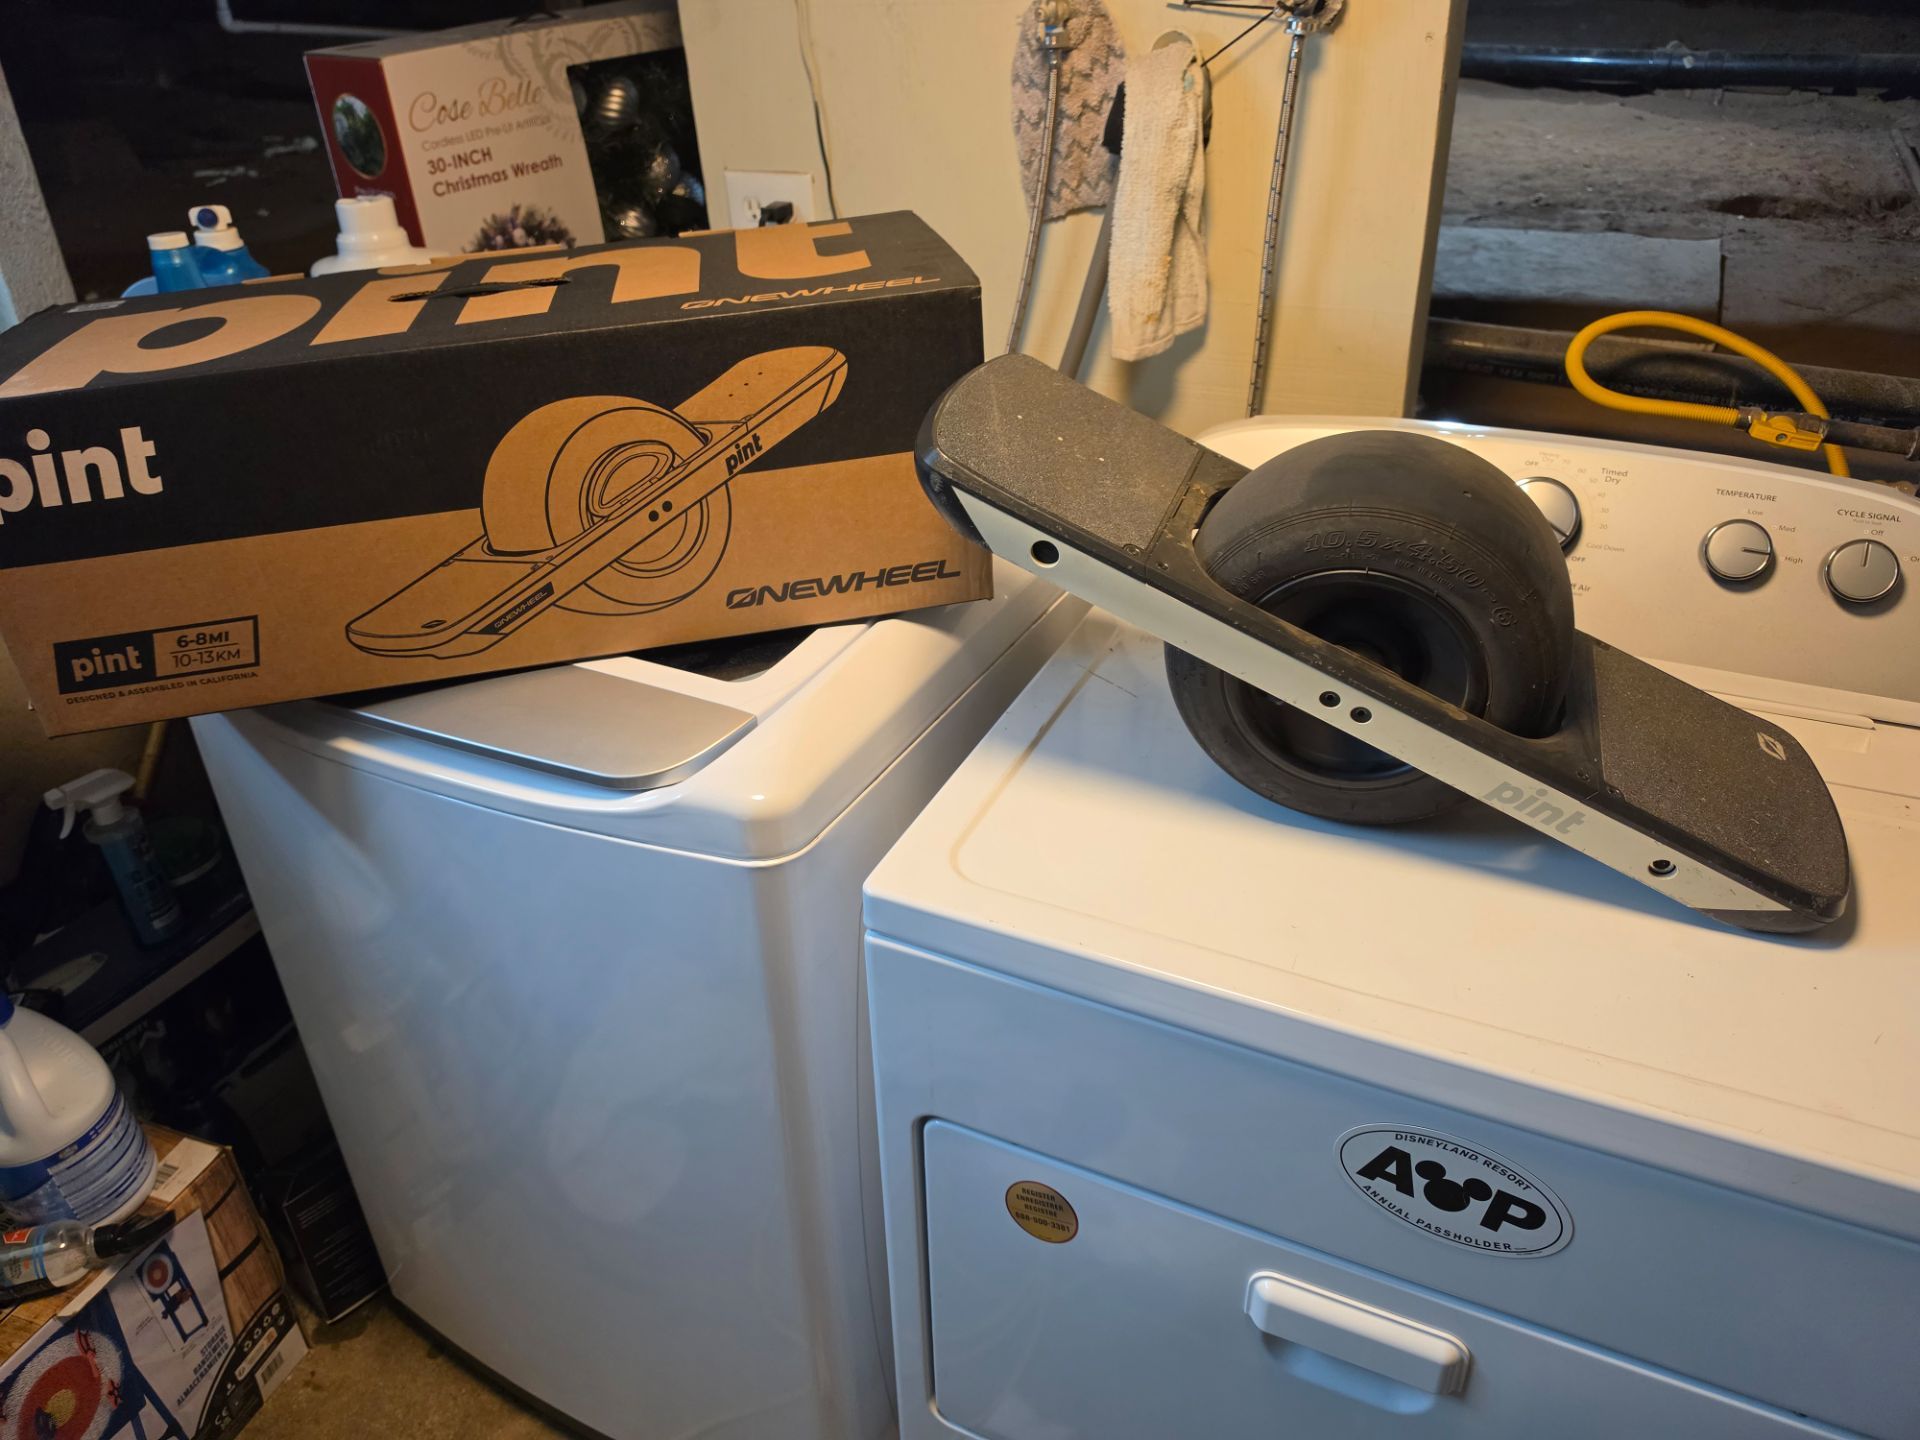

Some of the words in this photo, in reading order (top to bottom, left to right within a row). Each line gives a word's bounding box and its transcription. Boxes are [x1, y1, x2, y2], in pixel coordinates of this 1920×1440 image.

[409, 91, 472, 132] Cose
[477, 76, 544, 116] Belle
[465, 129, 484, 143] LED
[426, 147, 493, 176] 30-INCH
[432, 169, 508, 197] Christmas
[510, 153, 563, 178] Wreath
[725, 432, 763, 475] pint
[1601, 467, 1628, 477] Timed
[1604, 475, 1622, 485] Dry
[1716, 488, 1777, 502] TEMPERATURE
[1836, 508, 1866, 519] CYCLE
[1867, 511, 1902, 523] SIGNAL
[1870, 528, 1885, 536] Off
[1784, 555, 1804, 565] High
[71, 645, 142, 683] pint
[172, 648, 241, 669] 10-13KM
[66, 692, 116, 705] DESIGNED
[118, 690, 126, 698] &
[127, 682, 185, 696] ASSEMBLED
[199, 671, 258, 685] CALIFORNIA
[1482, 781, 1587, 834] pint
[1394, 1133, 1478, 1161] DISNEYLAND
[1483, 1159, 1532, 1191] RESORT
[1021, 1187, 1056, 1203] REGISTER
[1362, 1185, 1411, 1220] ANNUAL
[1415, 1217, 1512, 1251] PASSHOLDER
[200, 1325, 226, 1356] STORAGE
